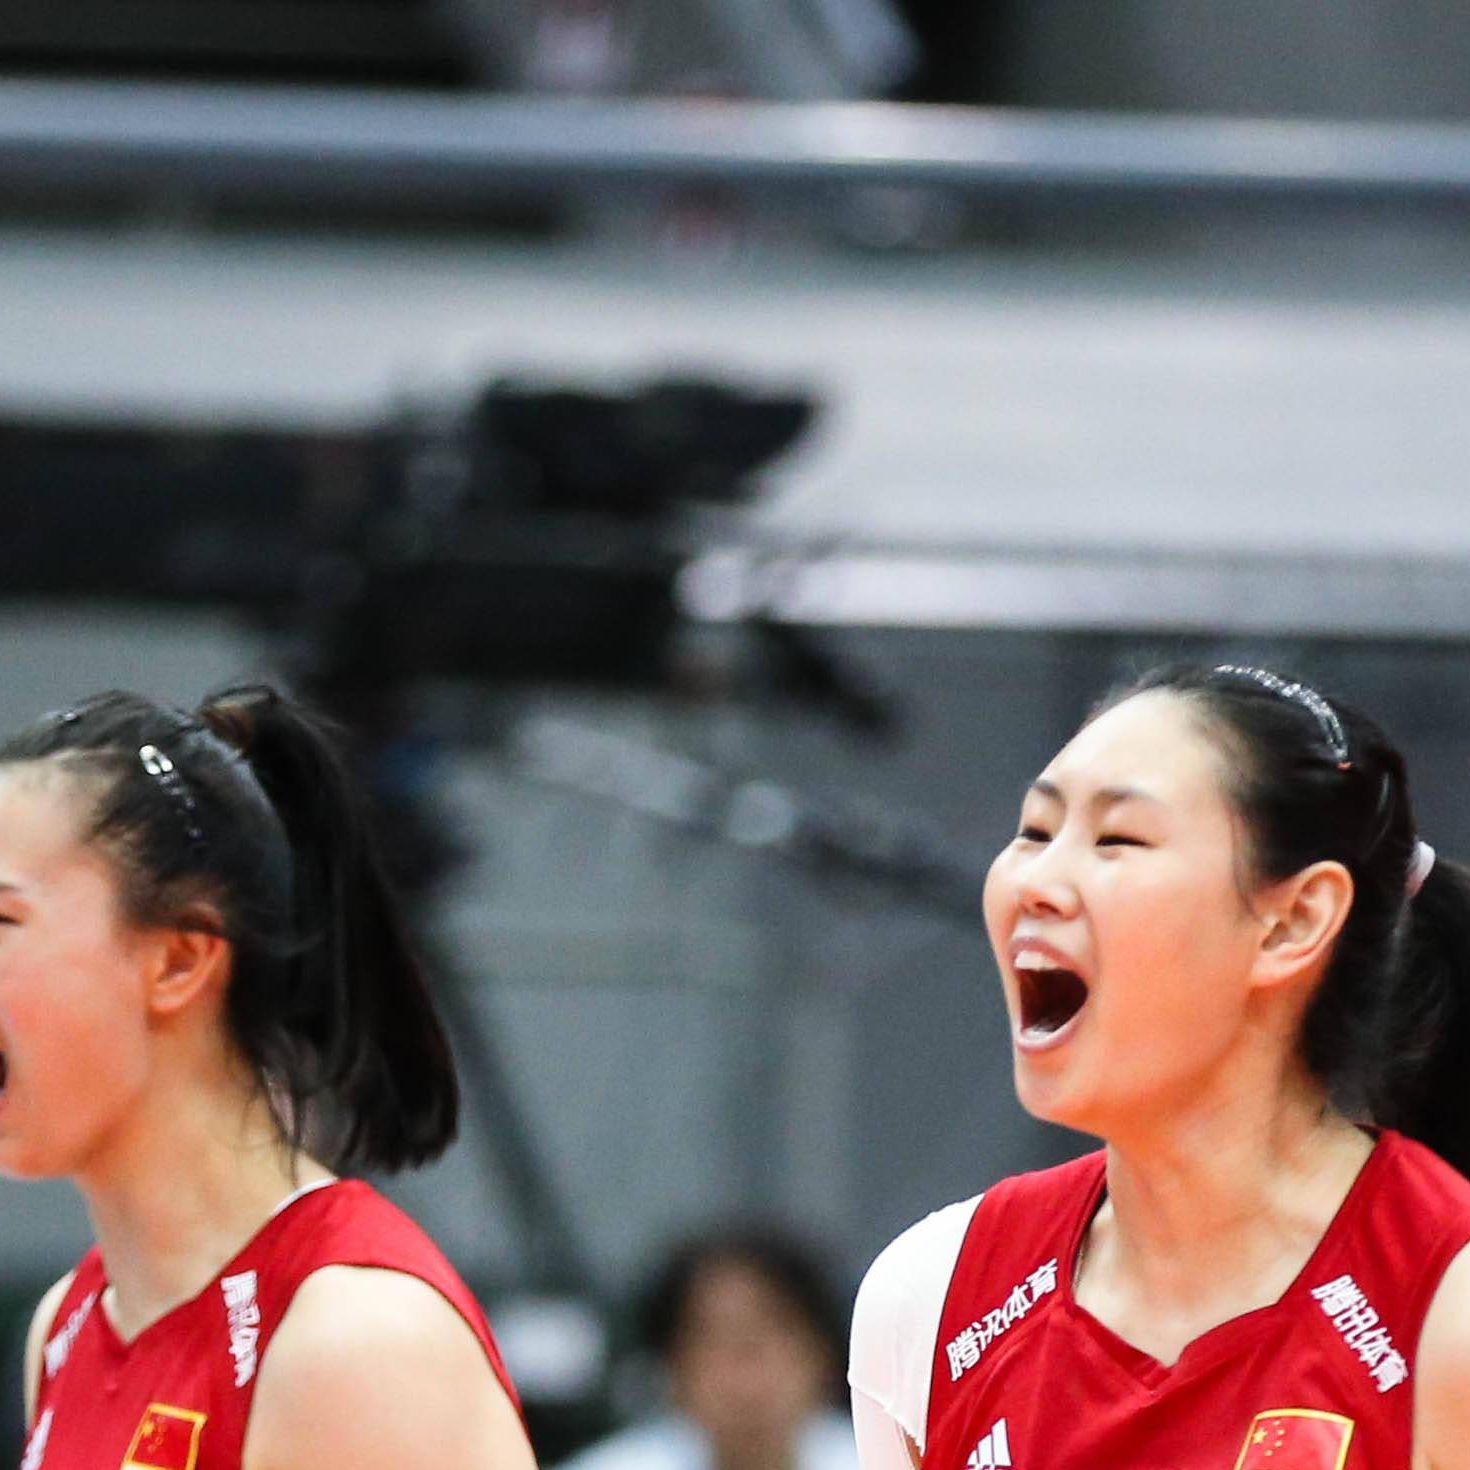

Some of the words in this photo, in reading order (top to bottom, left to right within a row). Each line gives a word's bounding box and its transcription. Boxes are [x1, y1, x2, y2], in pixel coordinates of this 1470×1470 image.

[945, 1257, 1059, 1382] 腾讯体育
[1310, 1274, 1409, 1393] 腾讯体育
